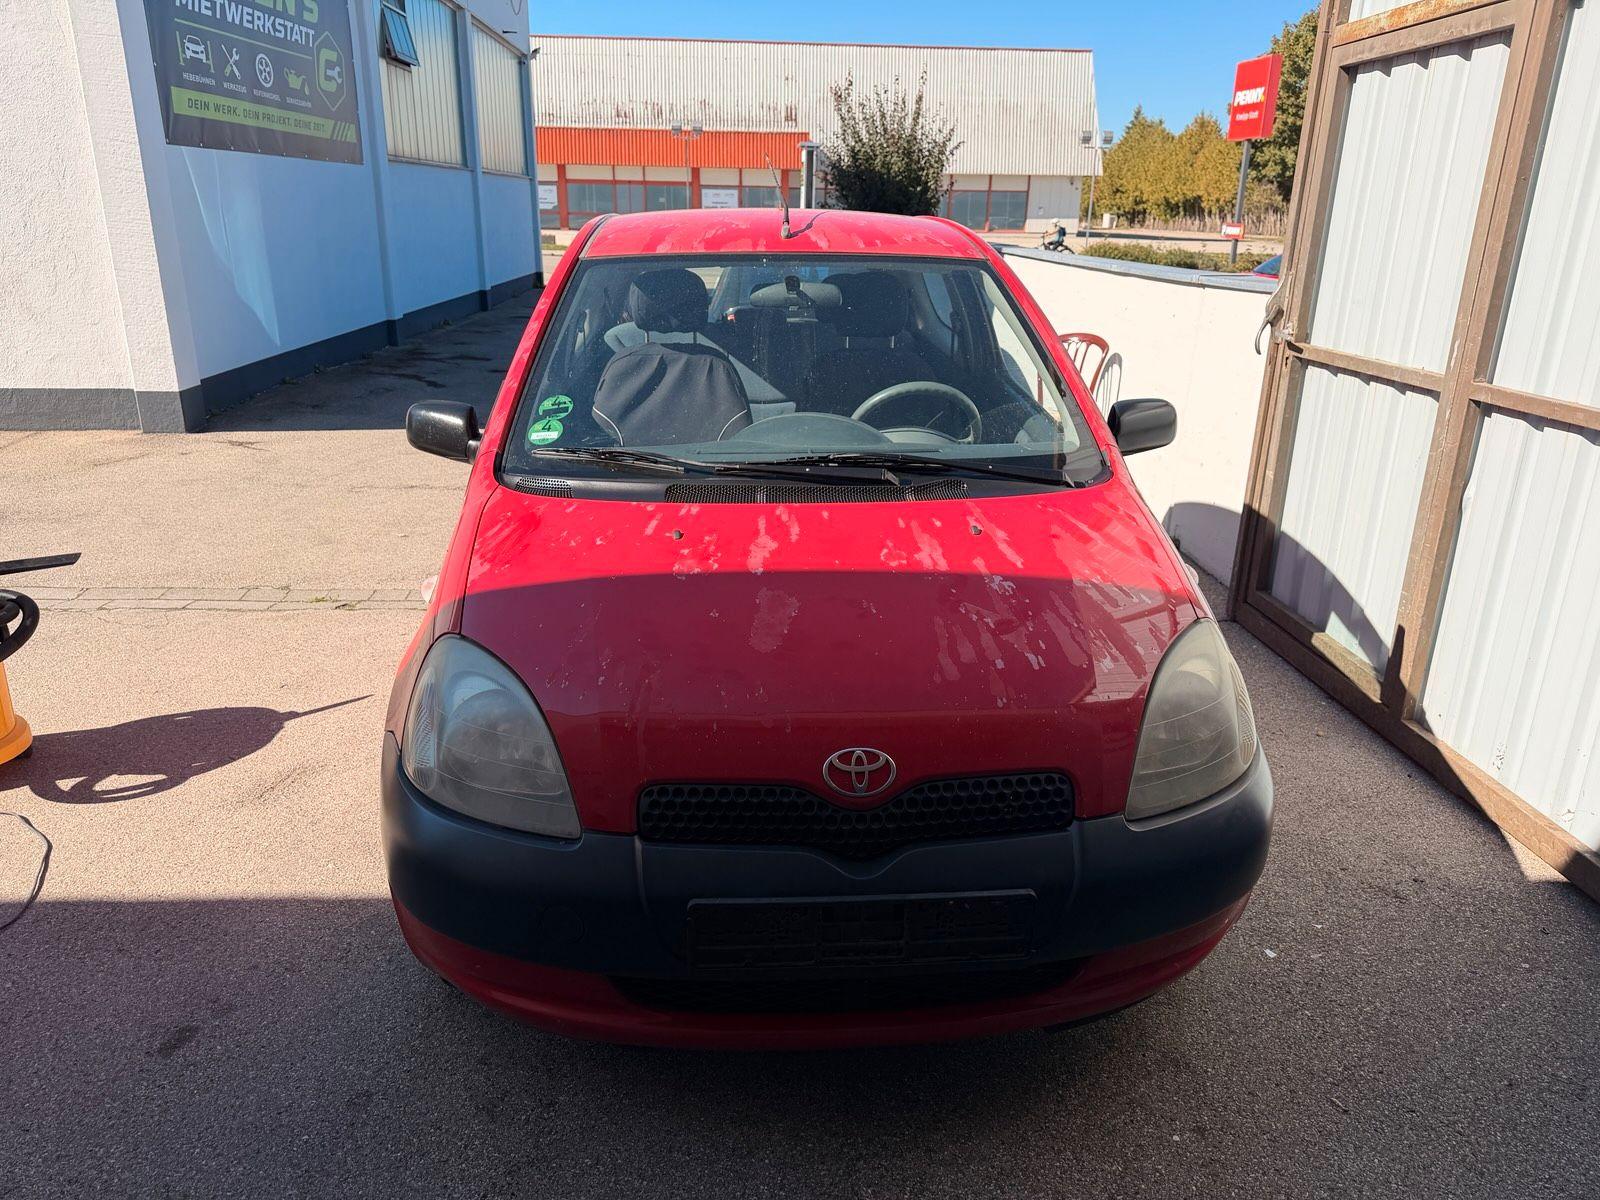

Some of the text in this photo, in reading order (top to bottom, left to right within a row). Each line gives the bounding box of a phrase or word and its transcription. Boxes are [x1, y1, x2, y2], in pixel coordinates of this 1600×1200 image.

[187, 98, 210, 112] DEIN
[213, 102, 241, 117] WERK.
[243, 108, 260, 121] DEIN
[541, 419, 552, 432] 4
